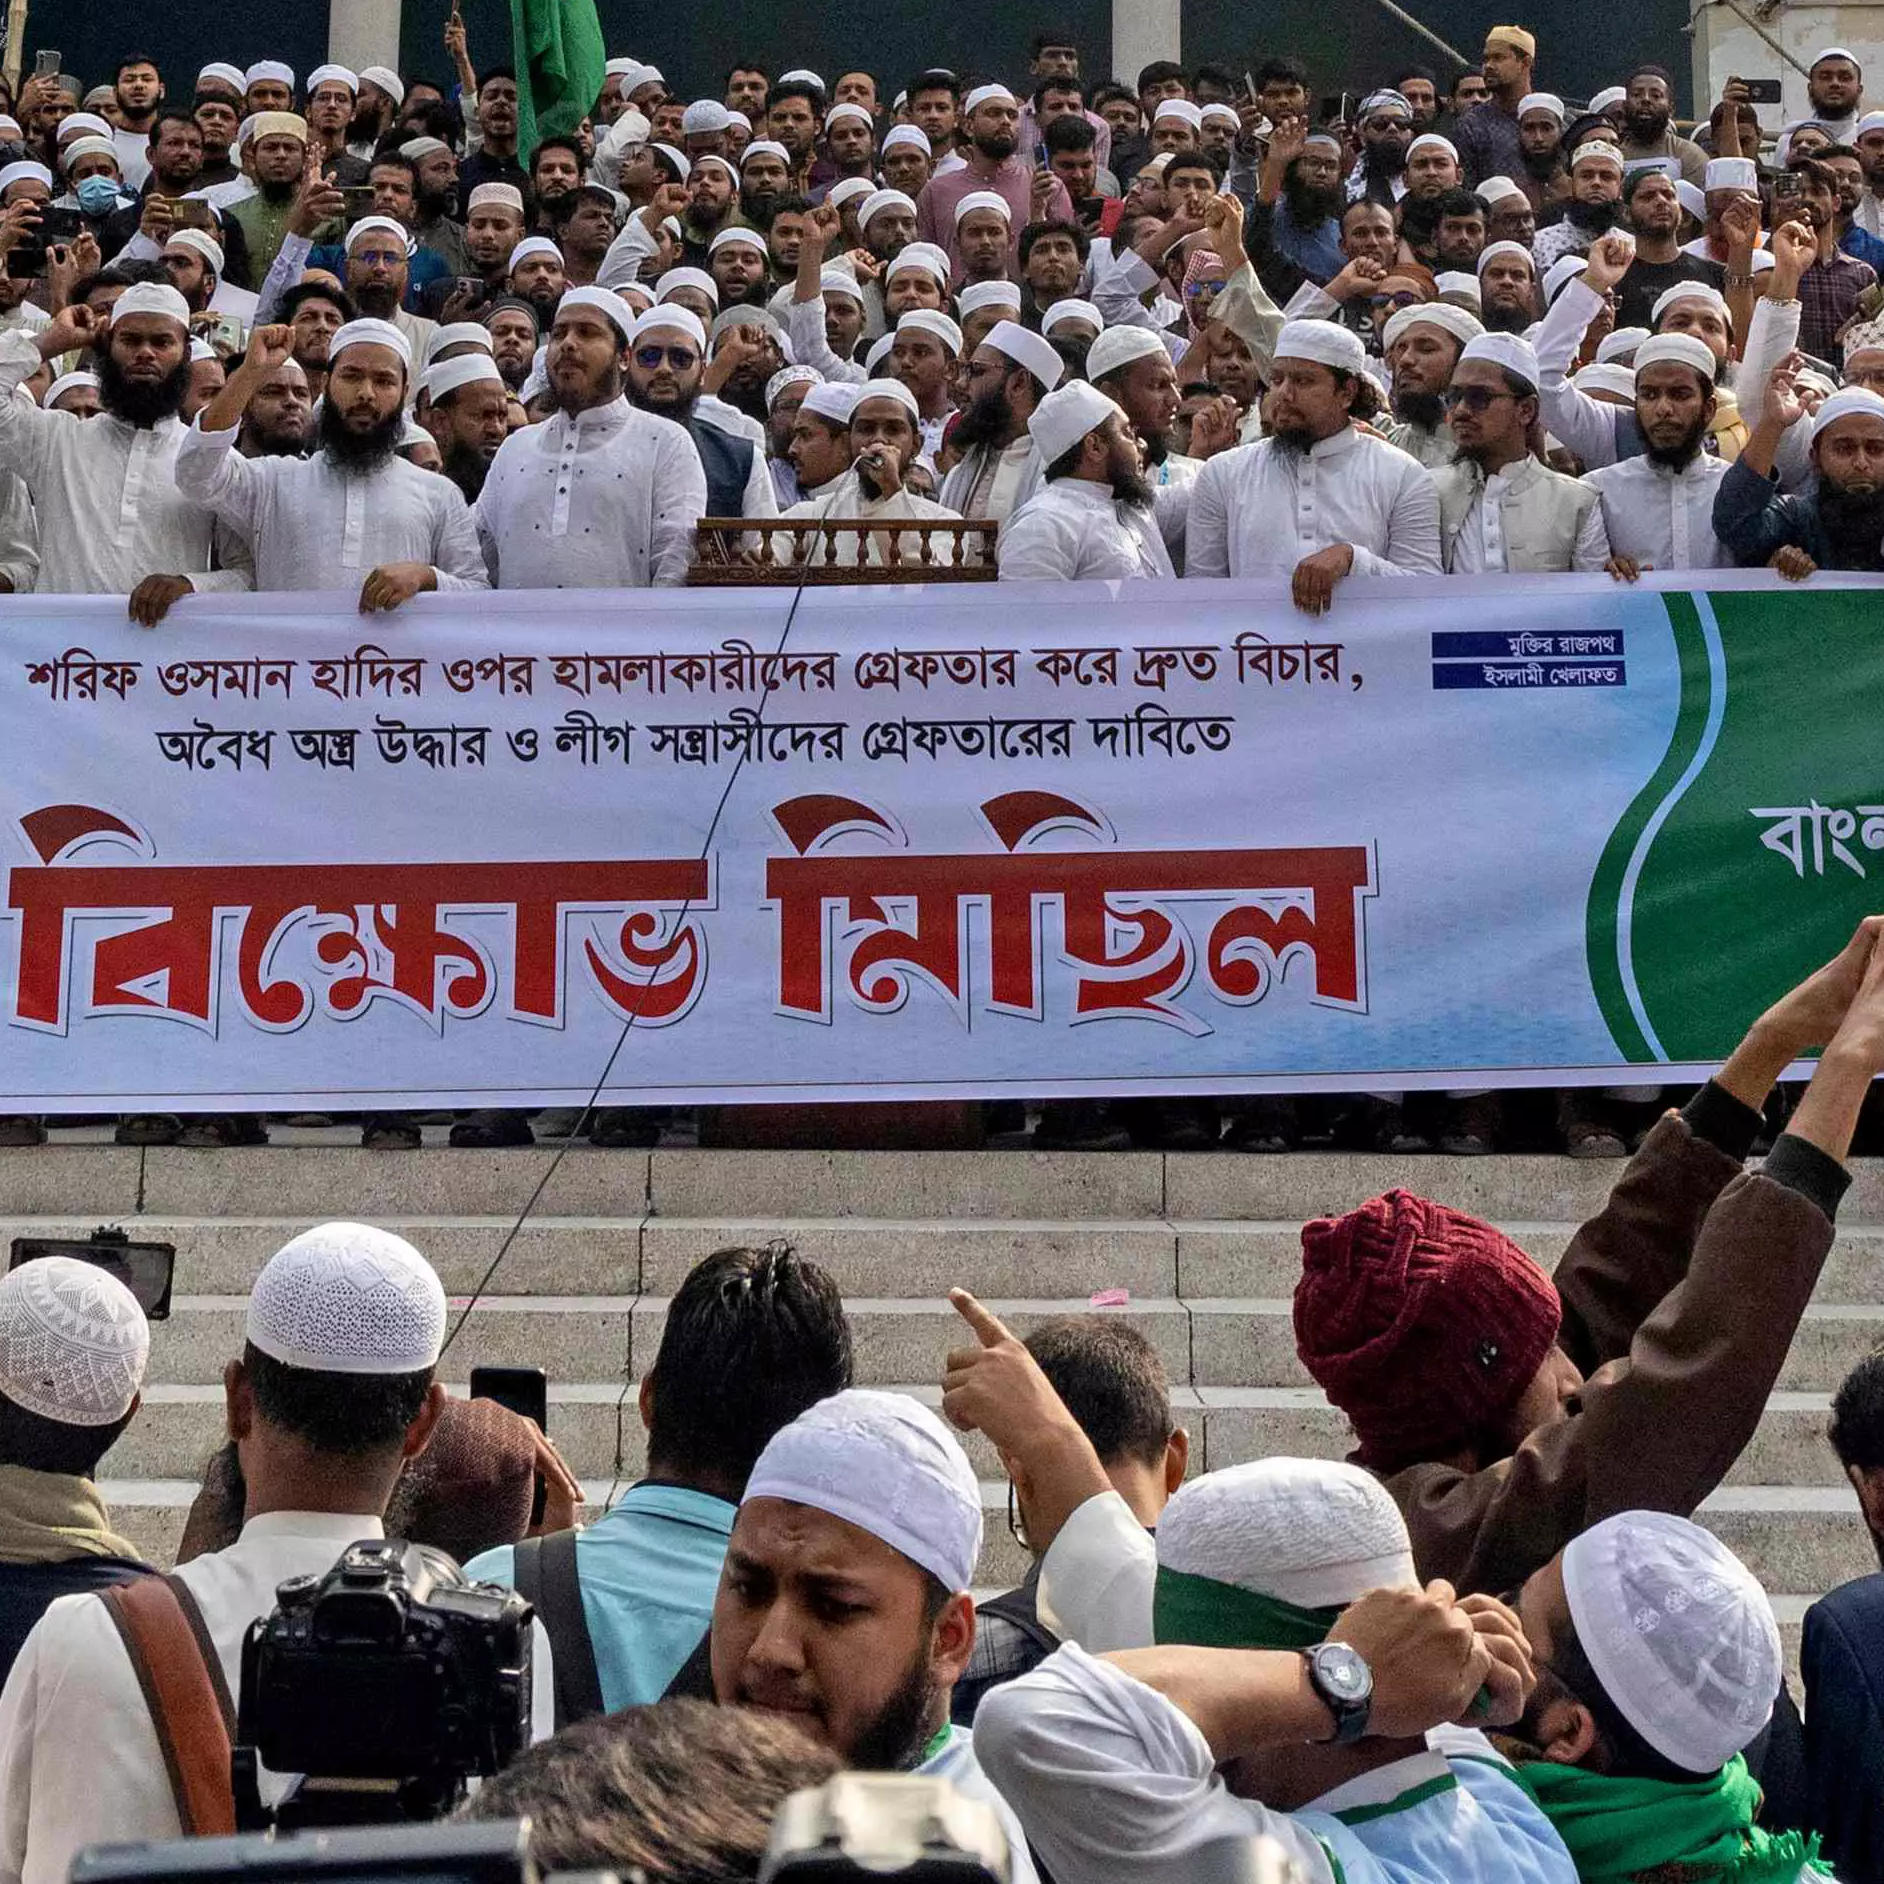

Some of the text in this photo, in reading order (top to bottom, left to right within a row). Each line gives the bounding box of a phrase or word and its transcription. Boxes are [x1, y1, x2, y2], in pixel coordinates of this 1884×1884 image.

[24, 632, 1364, 702] শরিফ ওসমান হাদির ওপর হামলাকারীদের গ্রেফতার করে দ্রুত বিচার,
[1482, 662, 1618, 687] ইসলামী খেলাফত
[1507, 632, 1616, 657] মুক্তির রাজপথ
[154, 701, 1236, 772] অবৈধ অস্ত্র উদ্ধার ও লীগ সন্ত্রাসীদের গ্রেফতারের দাবিতে
[6, 792, 1378, 1037] বিক্ষোভ মিছিল
